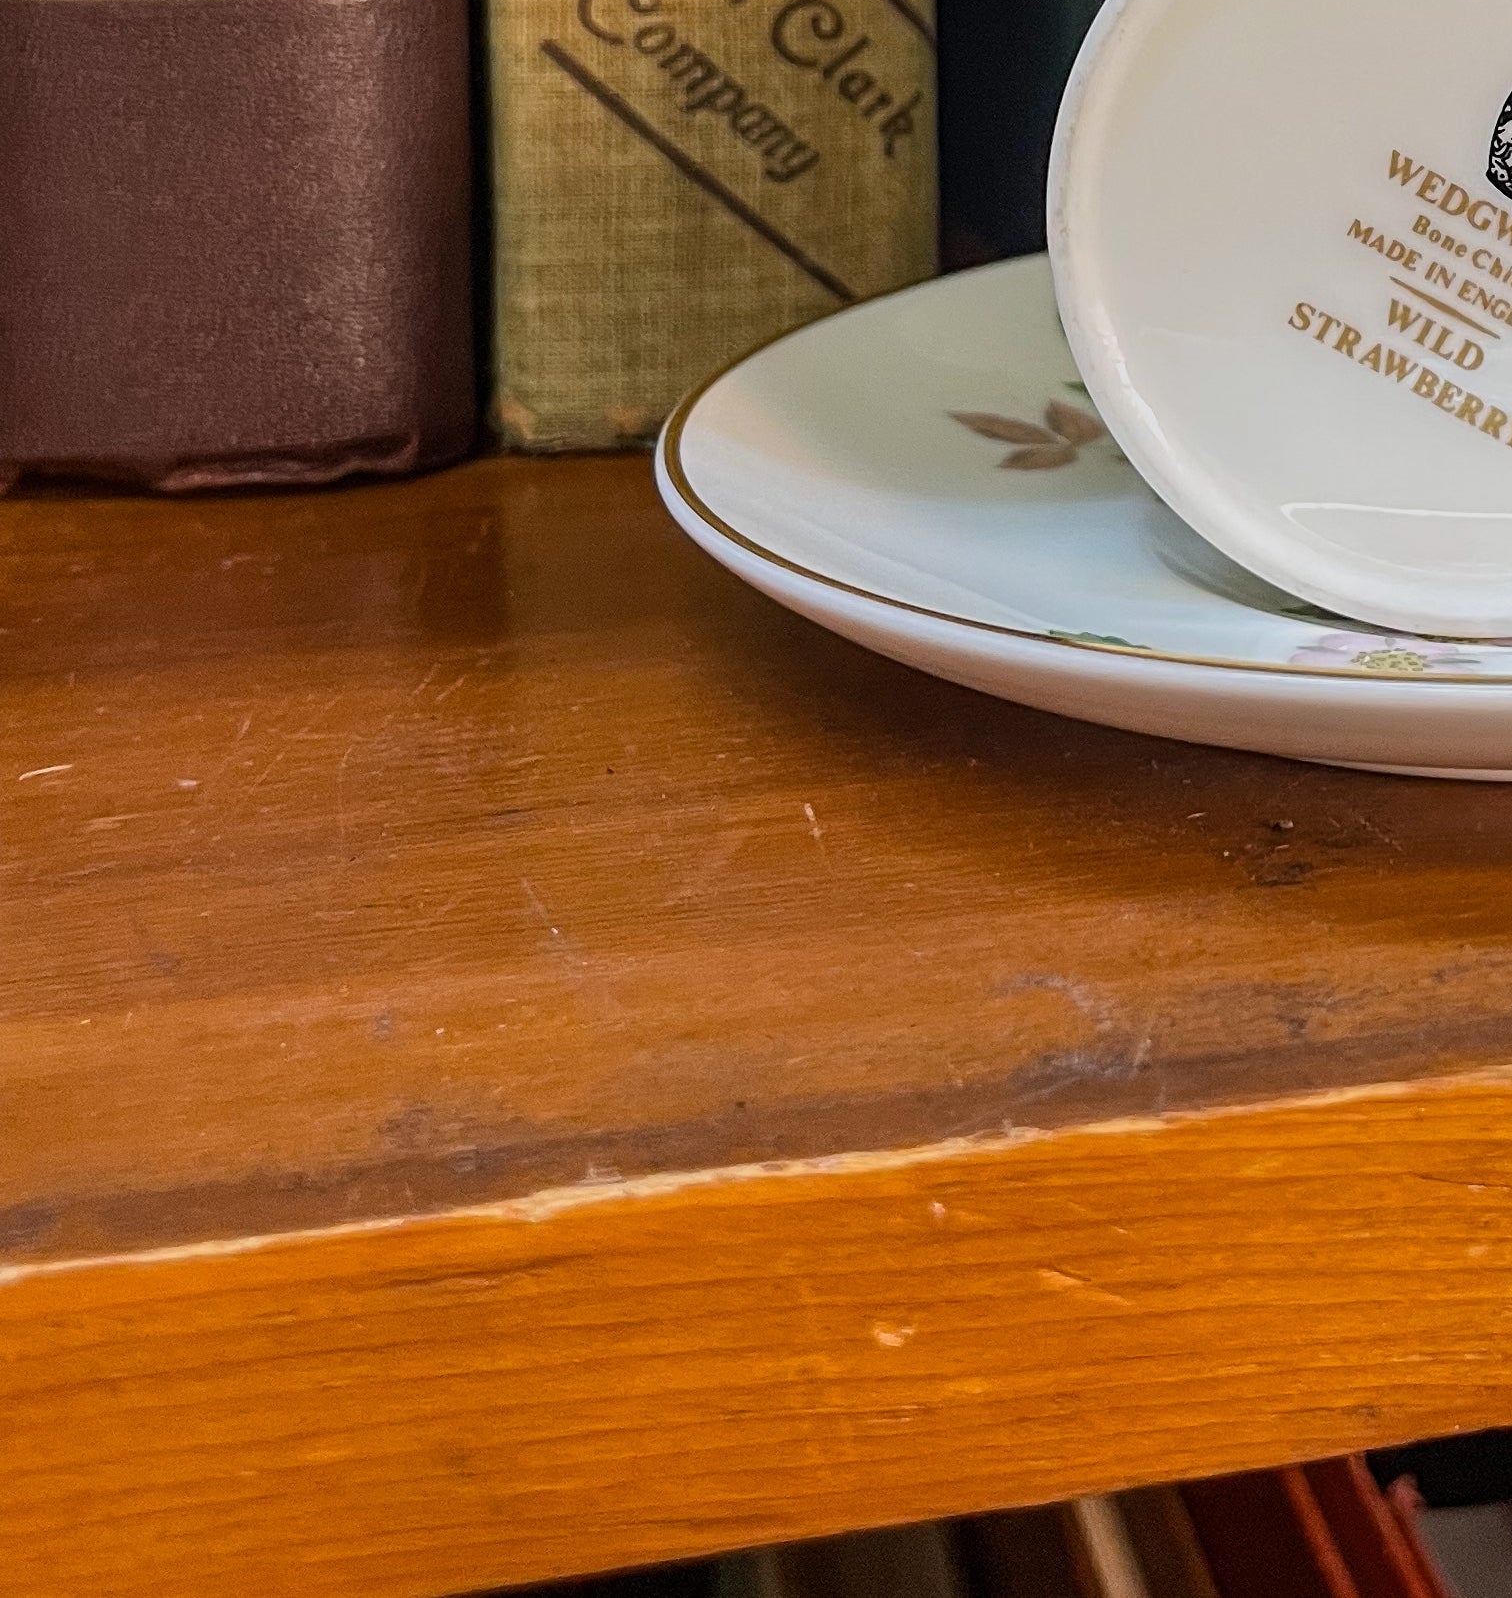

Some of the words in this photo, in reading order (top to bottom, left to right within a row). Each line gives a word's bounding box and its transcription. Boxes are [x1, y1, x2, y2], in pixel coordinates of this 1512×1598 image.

[1347, 218, 1423, 272] MADE
[1424, 260, 1457, 290] IN
[1411, 214, 1468, 259] Bone
[1387, 298, 1486, 372] WILD
